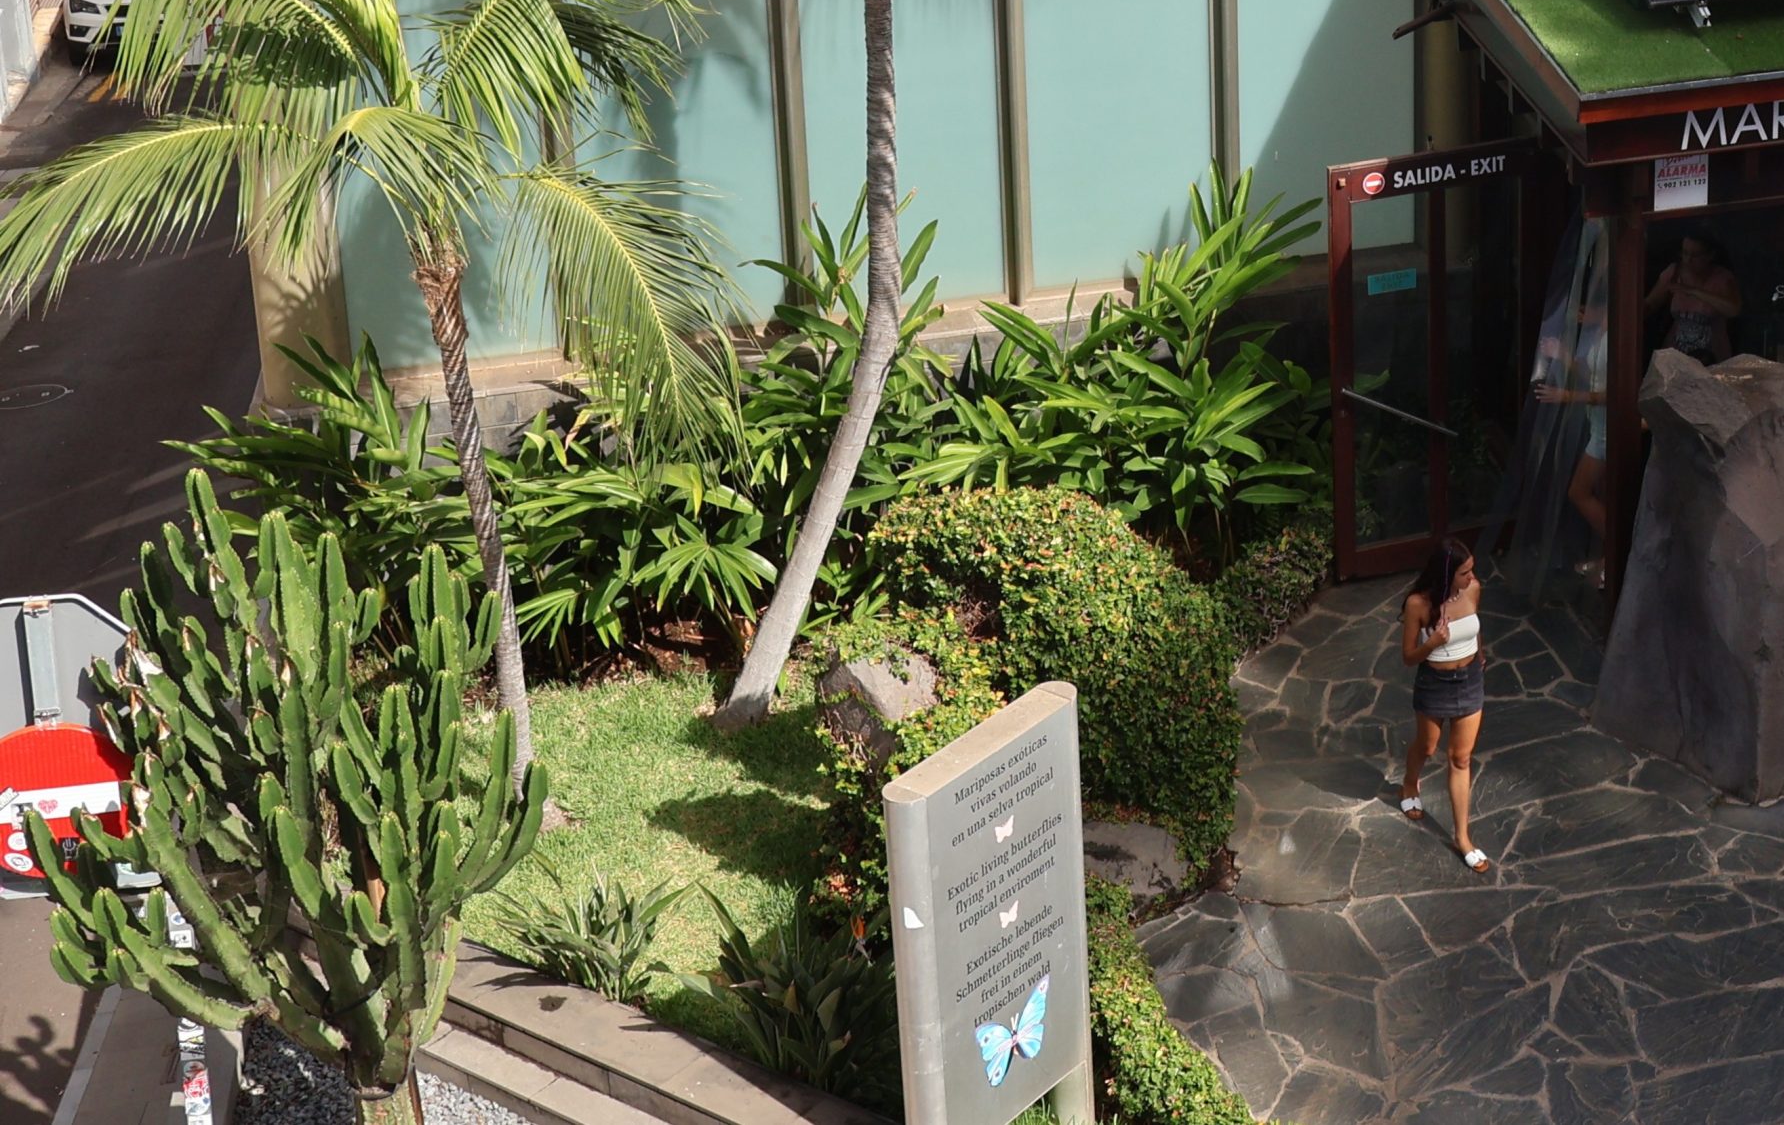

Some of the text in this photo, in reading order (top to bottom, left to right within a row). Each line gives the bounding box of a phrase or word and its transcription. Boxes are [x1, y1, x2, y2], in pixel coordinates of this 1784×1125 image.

[1393, 163, 1456, 189] SALIDA
[1470, 155, 1506, 176] EXIT
[1657, 164, 1707, 179] ALARMA
[954, 735, 1048, 805] Mariposas exóticas
[970, 761, 1037, 813] vivas volando
[952, 766, 1054, 847] en una selva tropical
[947, 813, 1062, 901] Exotic living butterflies
[956, 833, 1057, 915] flying in a wonderful
[959, 856, 1055, 933] tropical enviroment
[956, 916, 1064, 1003] Schmetterlinge fliegen
[966, 904, 1053, 975] Exotische lebende
[974, 960, 1051, 1028] tropischen wald
[981, 951, 1042, 1003] frei in einem
